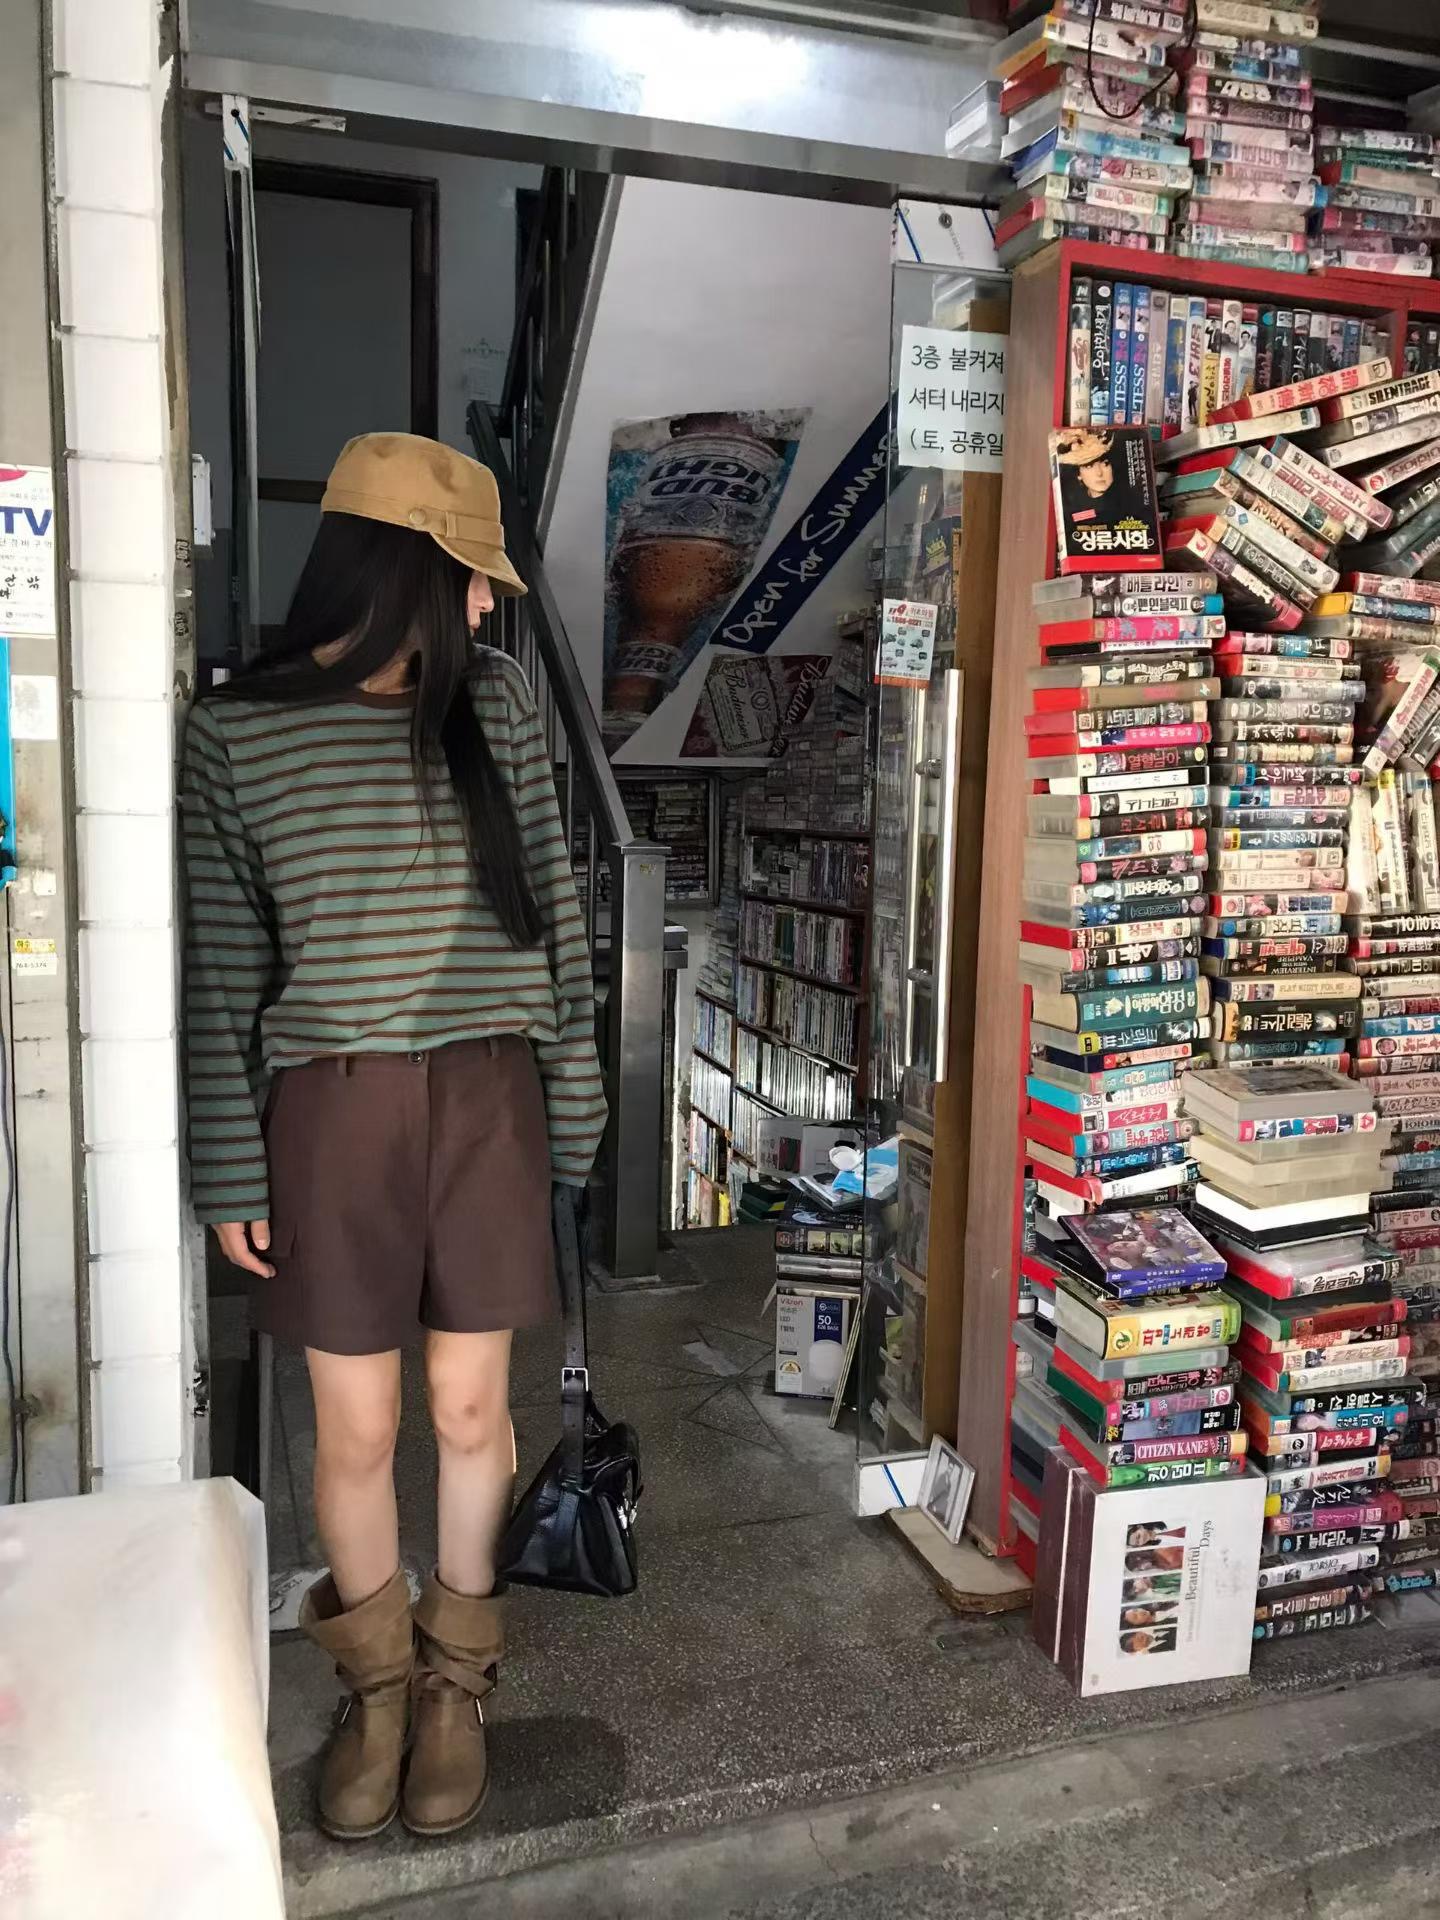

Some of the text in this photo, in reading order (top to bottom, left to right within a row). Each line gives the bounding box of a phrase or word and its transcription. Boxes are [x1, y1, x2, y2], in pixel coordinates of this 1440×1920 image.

[911, 345, 941, 370] 3층
[909, 387, 1005, 416] 셔터 내리지
[950, 431, 1004, 455] 공휴일
[1072, 530, 1154, 552] 상류사회
[724, 657, 752, 740] Budweiser
[1129, 748, 1181, 771] 열혈남아
[1271, 966, 1317, 975] INTERVIEW
[1158, 988, 1185, 1014] 함정
[1260, 1013, 1313, 1031] 쉰들러 리스트
[818, 1315, 831, 1325] 50
[1170, 1324, 1210, 1342] 노래방
[1138, 1441, 1204, 1459] CITIZEN KANE
[1200, 1520, 1212, 1547] Days
[1185, 1546, 1201, 1601] Beautiful
